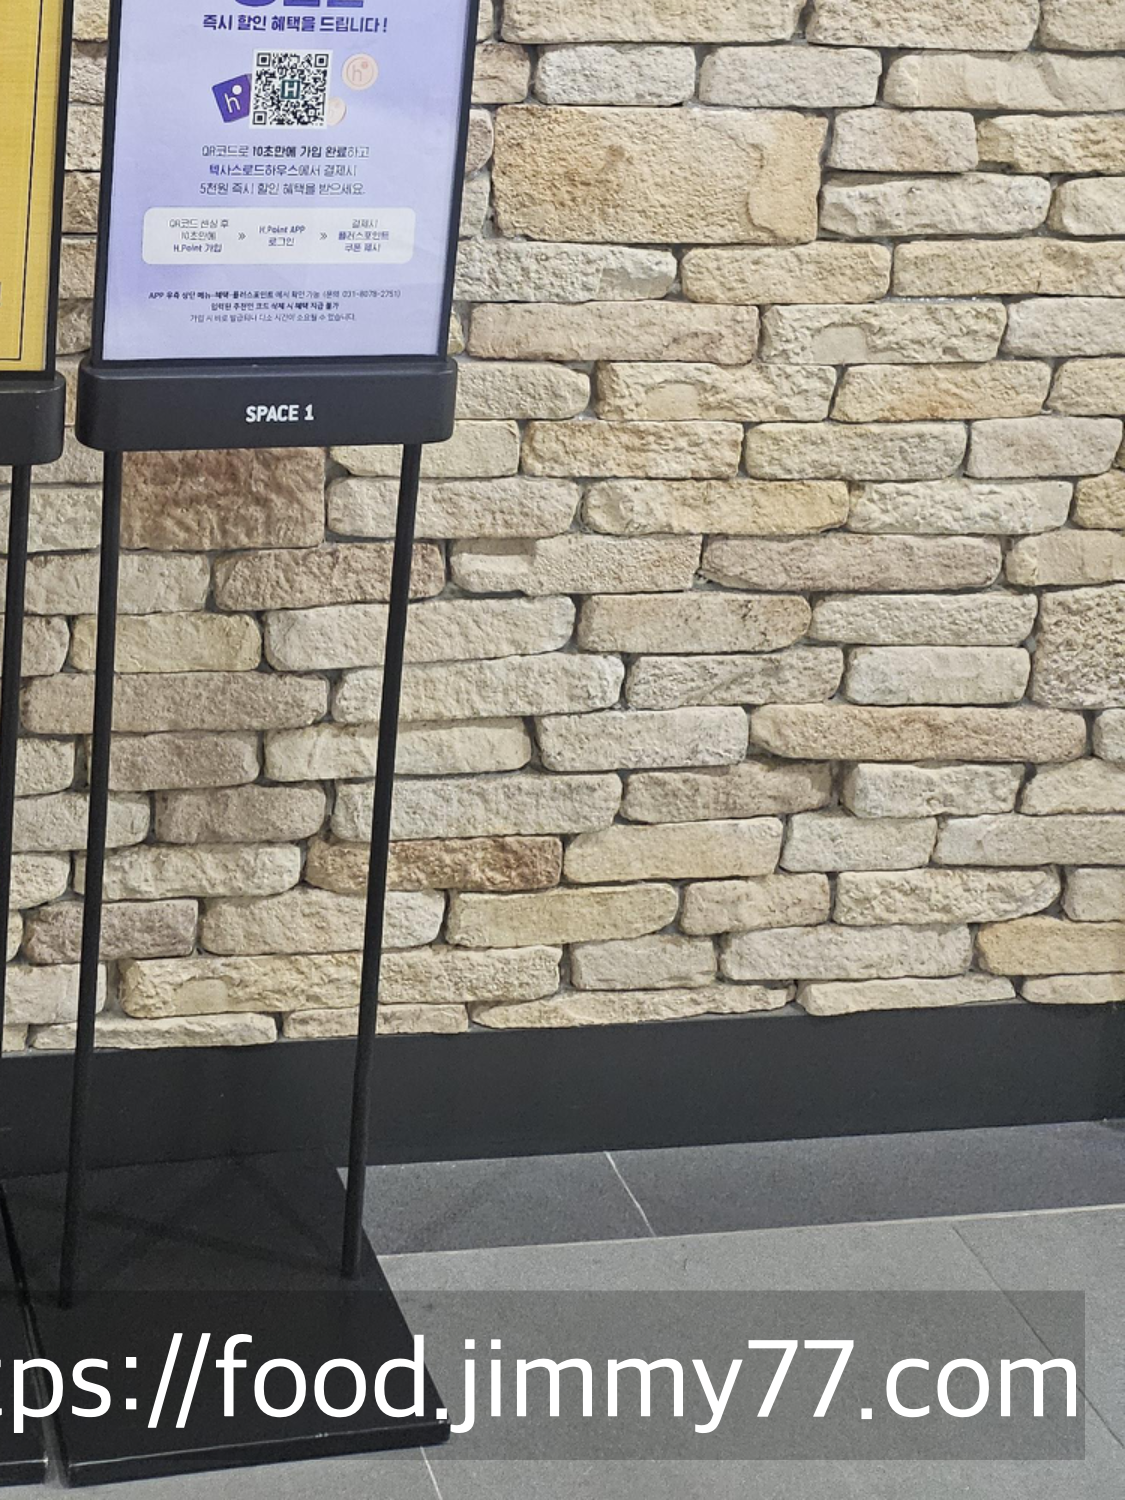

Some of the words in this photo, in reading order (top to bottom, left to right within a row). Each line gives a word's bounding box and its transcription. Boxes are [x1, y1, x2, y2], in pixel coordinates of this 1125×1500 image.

[203, 14, 232, 31] 즉시
[237, 14, 267, 32] 할인
[271, 15, 315, 32] 혜택을
[202, 145, 249, 158] QR코드로
[253, 145, 296, 158] 10초만에
[300, 145, 322, 158] 가입
[325, 146, 369, 159] 완료하고
[209, 163, 321, 178] 텍사스로드하우스에서
[324, 164, 357, 178] 결제시
[200, 182, 229, 196] 5천원
[233, 182, 255, 196] 즉시
[257, 183, 280, 196] 할인
[283, 183, 316, 196] 혜택을
[319, 183, 365, 196] 받으세요.
[246, 405, 299, 423] SPACE
[305, 404, 314, 421] 1
